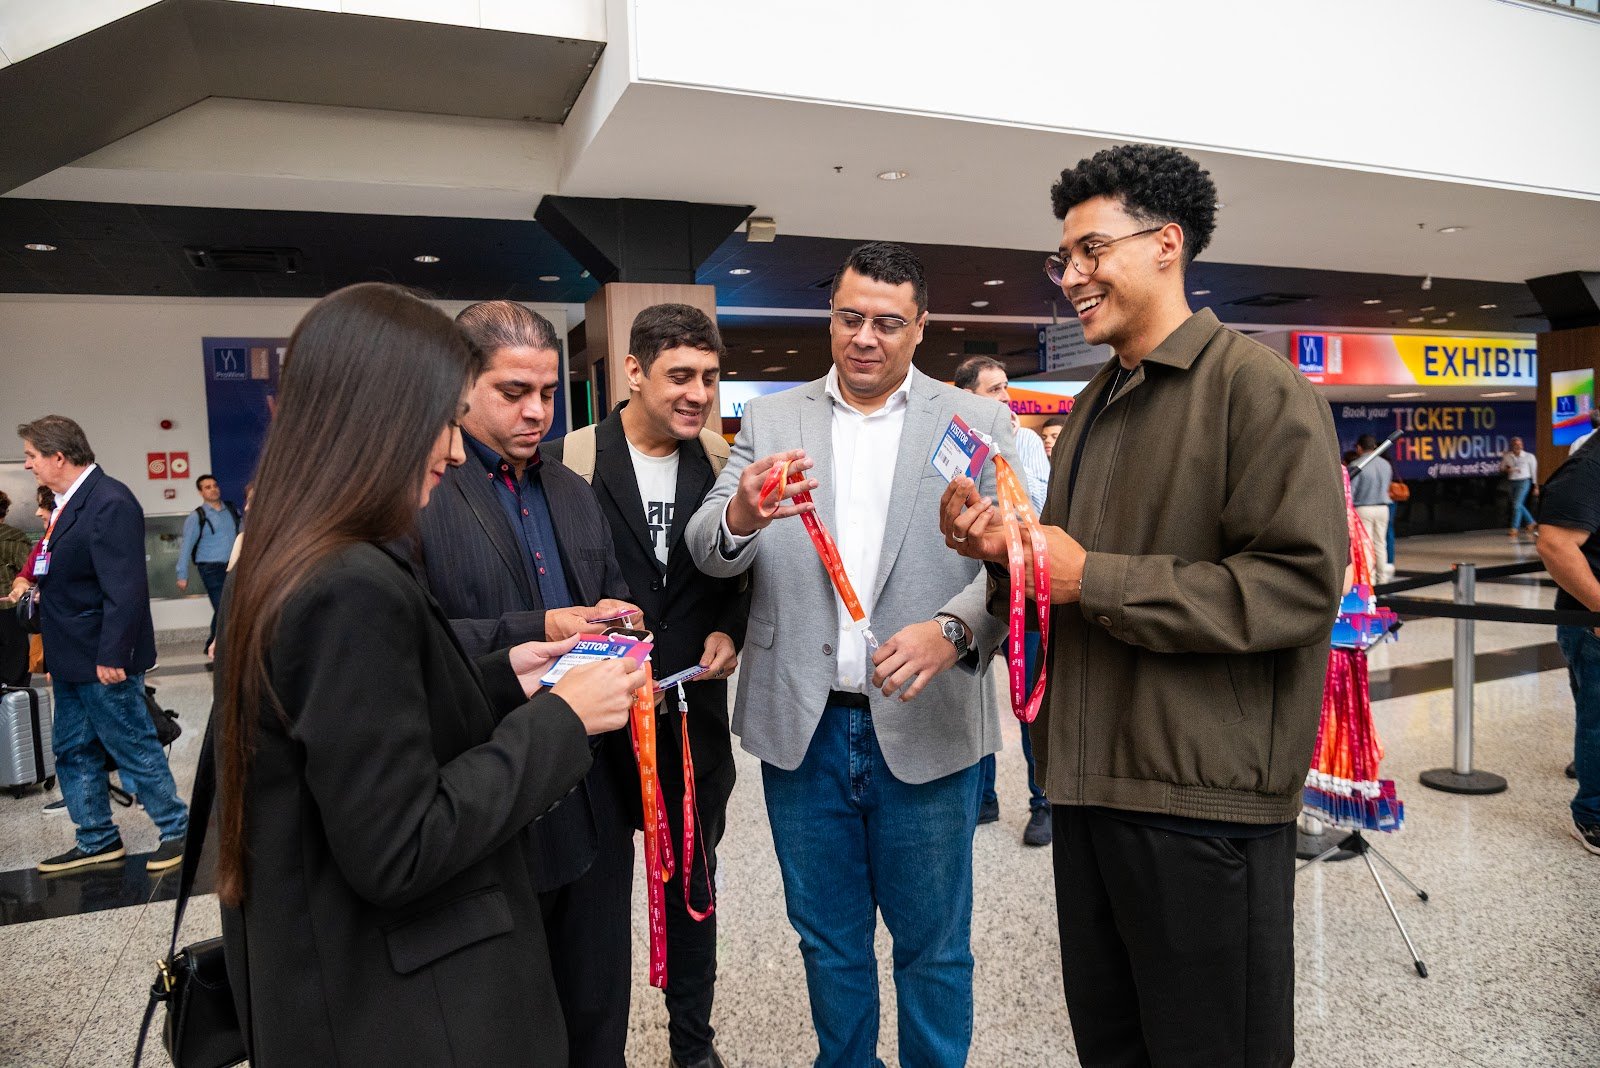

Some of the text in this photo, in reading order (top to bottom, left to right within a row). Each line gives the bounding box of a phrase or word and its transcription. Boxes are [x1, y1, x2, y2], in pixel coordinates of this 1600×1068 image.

[1424, 345, 1537, 377] EXHIBIT
[1008, 400, 1042, 414] ВАТЬ
[1342, 406, 1389, 421] Book your
[1392, 406, 1496, 431] TICKET TO
[951, 421, 969, 445] VISITOR
[1396, 434, 1509, 461] THE WORLD
[1428, 463, 1439, 478] of
[1439, 463, 1461, 475] Wine
[1462, 461, 1480, 474] and
[575, 641, 610, 651] ISITOR
